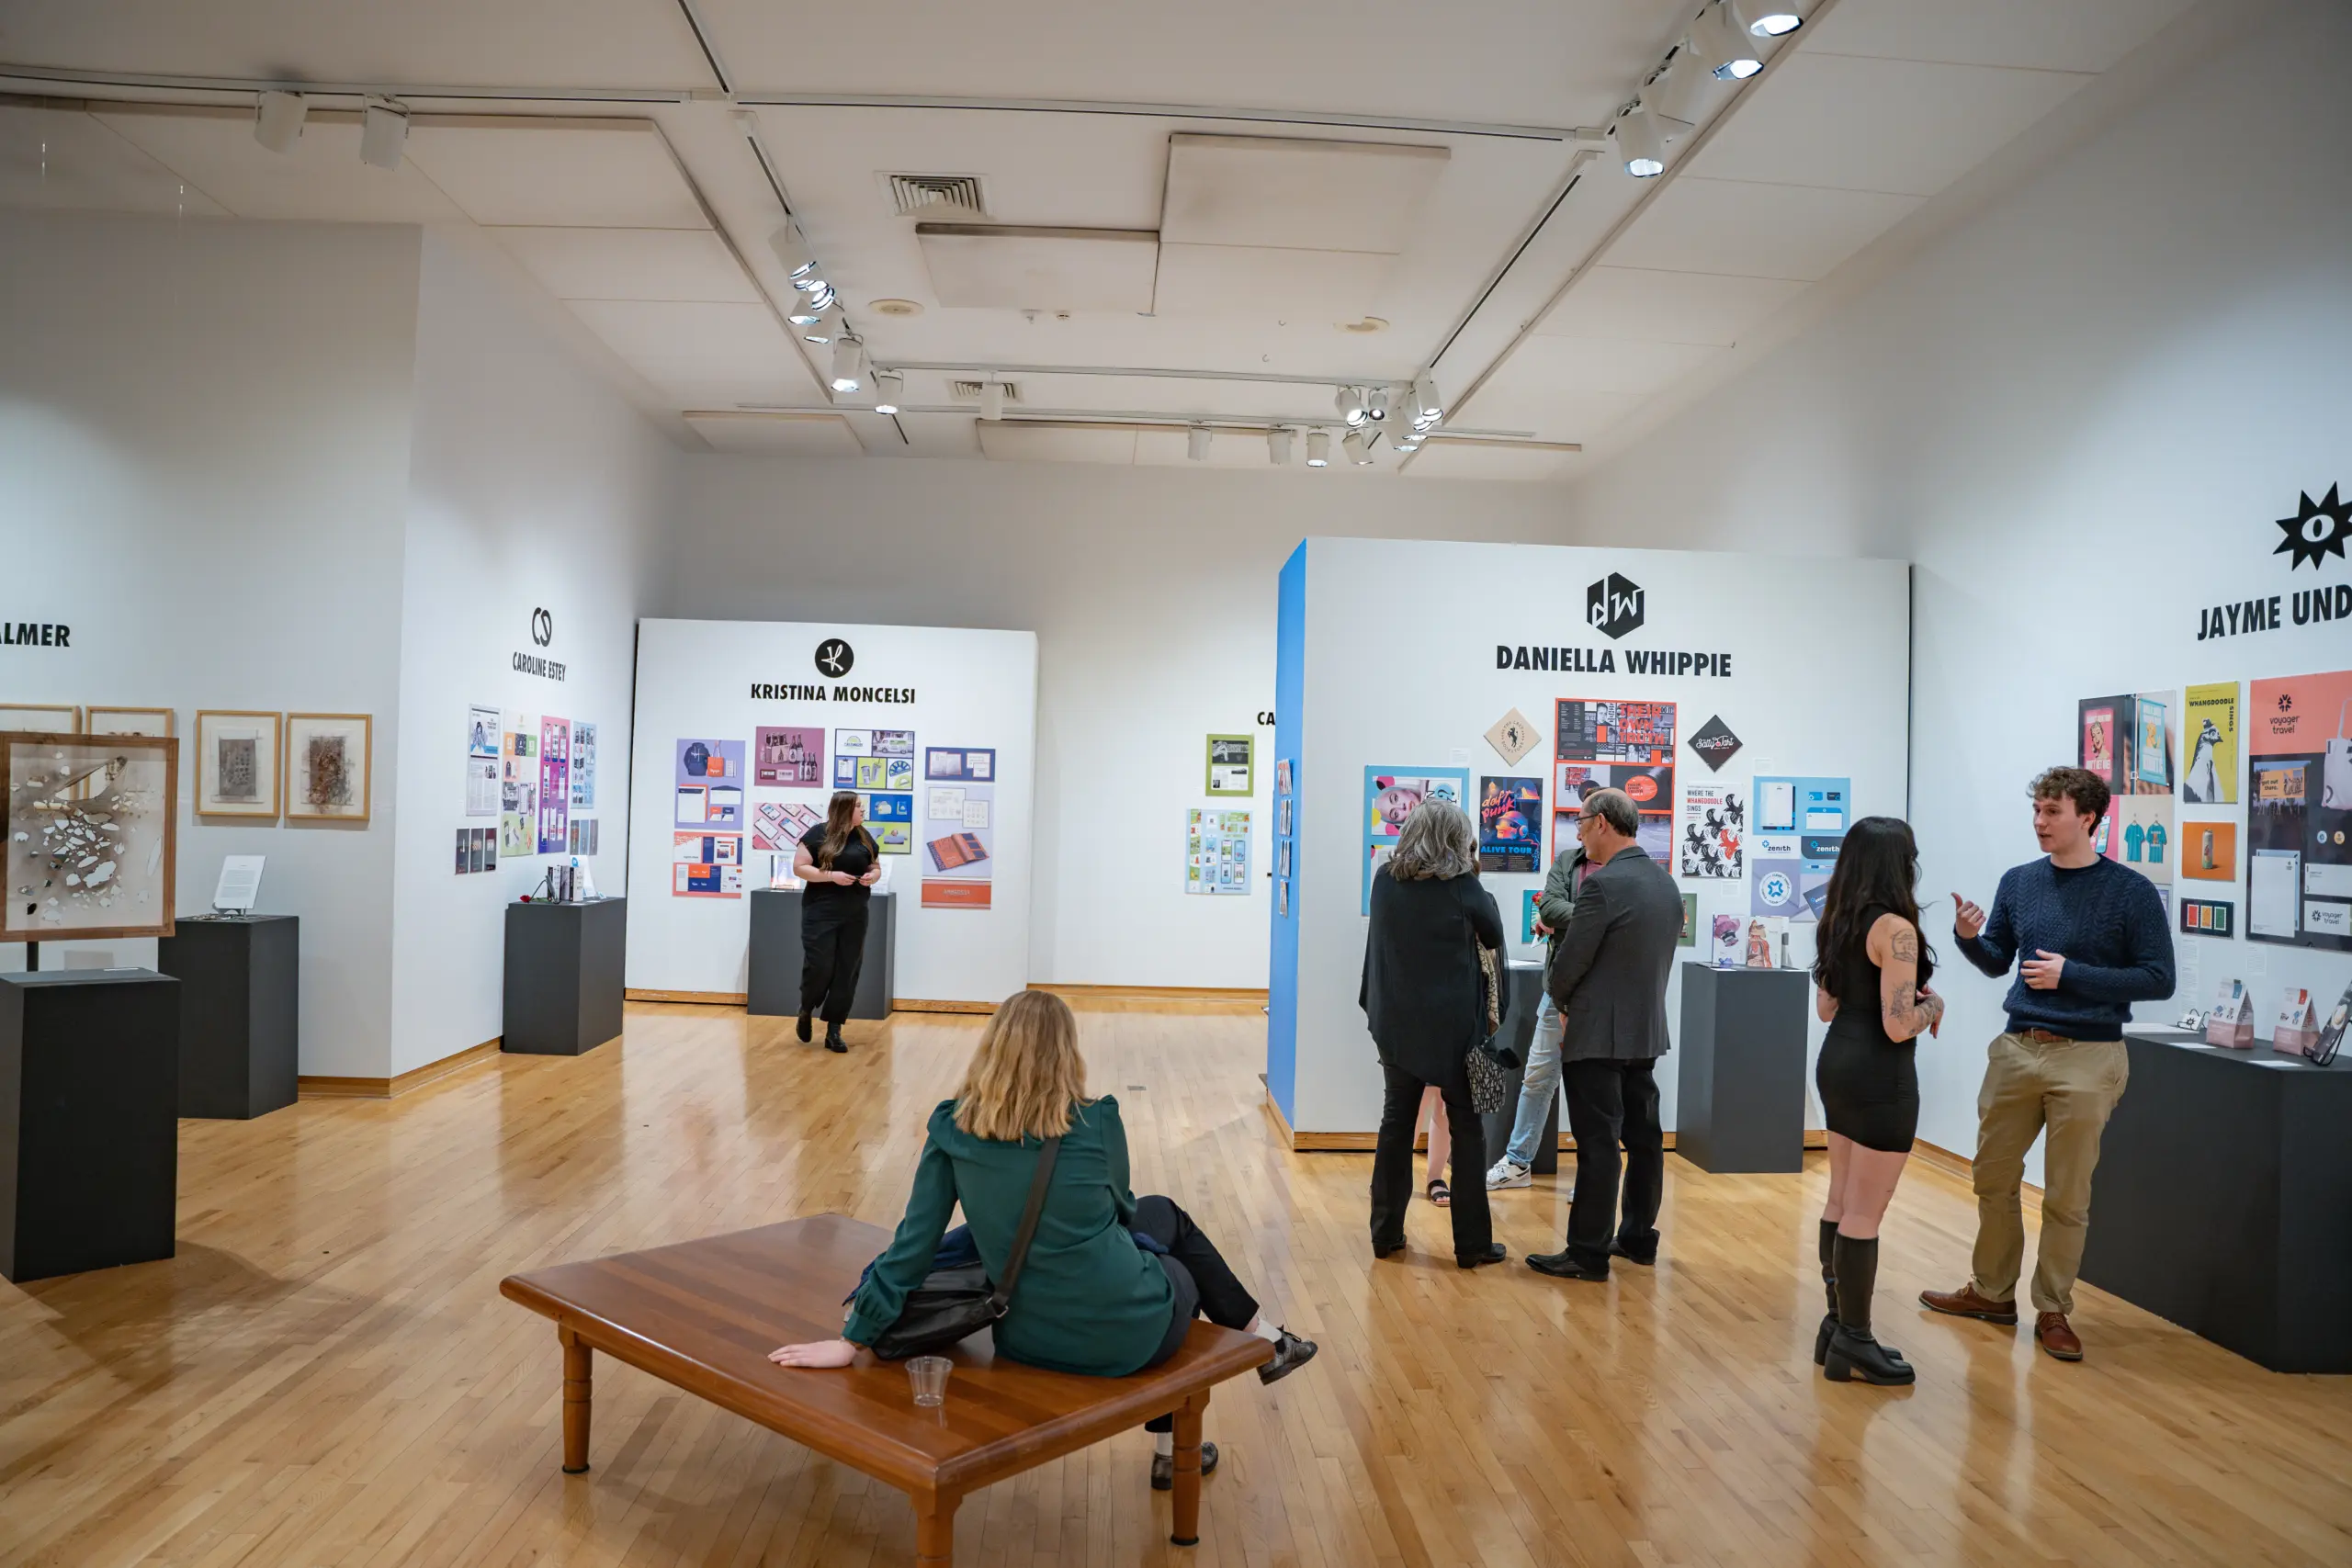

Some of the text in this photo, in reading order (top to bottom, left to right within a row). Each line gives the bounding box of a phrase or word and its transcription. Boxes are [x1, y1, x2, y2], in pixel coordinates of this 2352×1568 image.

[2197, 583, 2352, 641] JAYME UND
[0, 622, 71, 648] LMER
[513, 651, 566, 682] CAROLINE ESTEY
[1497, 645, 1732, 677] DANIELLA WHIPPIE
[751, 683, 916, 705] KRISTINA MONCELSI
[1618, 703, 1662, 718] THEIR
[1617, 717, 1655, 731] OWN
[2269, 716, 2300, 726] voyager
[2272, 725, 2295, 734] travel
[1618, 732, 1665, 746] TRUTH
[1481, 789, 1515, 807] daft
[1481, 796, 1516, 824] punk
[1480, 845, 1532, 854] ALIVE TOUR
[2321, 911, 2343, 919] voyager
